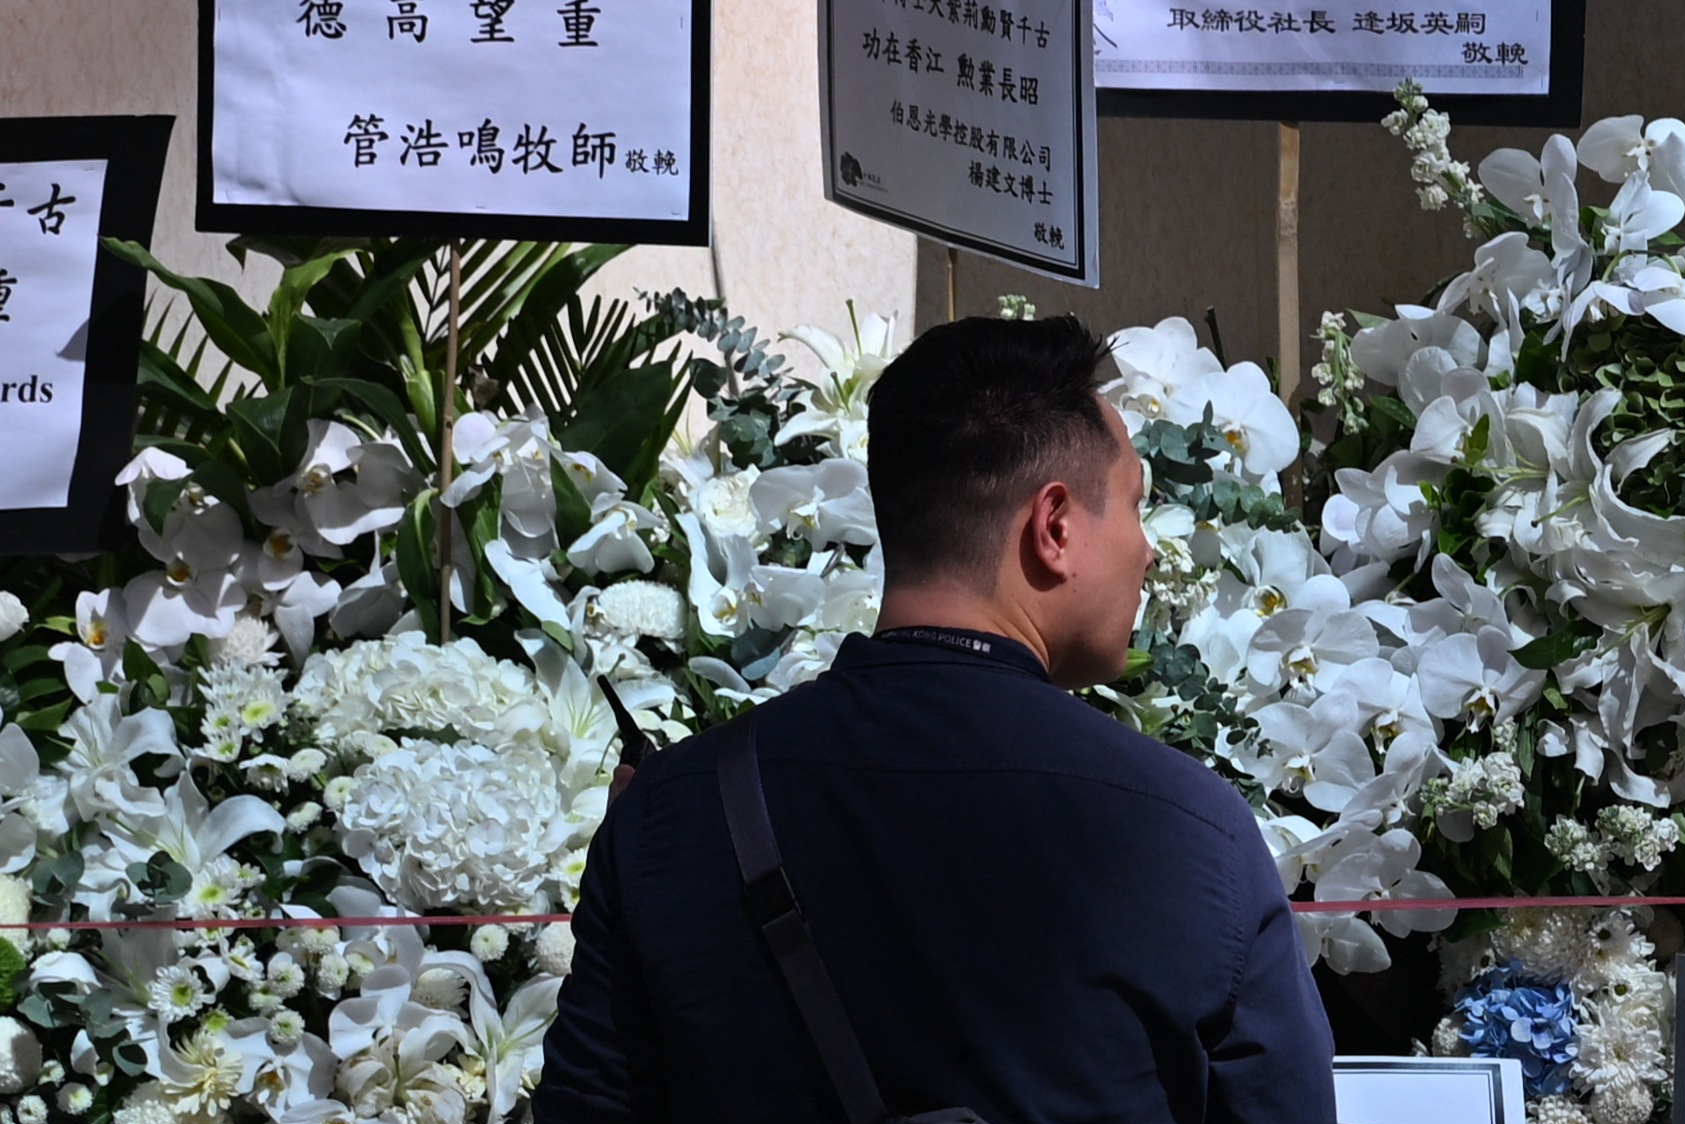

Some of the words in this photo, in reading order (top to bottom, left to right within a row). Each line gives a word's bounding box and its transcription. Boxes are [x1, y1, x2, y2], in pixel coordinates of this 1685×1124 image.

[1168, 8, 1336, 33] 取締役社長
[1352, 10, 1487, 35] 逢坂英嗣
[862, 27, 945, 74] 功在香江
[956, 52, 1040, 106] 勳業長昭
[1461, 42, 1528, 65] 敬輓
[344, 114, 617, 179] 管浩鳴牧師
[625, 149, 680, 176] 敬輓
[890, 100, 1053, 173] 伯恩光學控股有限公司
[968, 160, 1053, 206] 楊建文博士
[1033, 221, 1065, 250] 敬輓
[938, 633, 971, 648] POLICE
